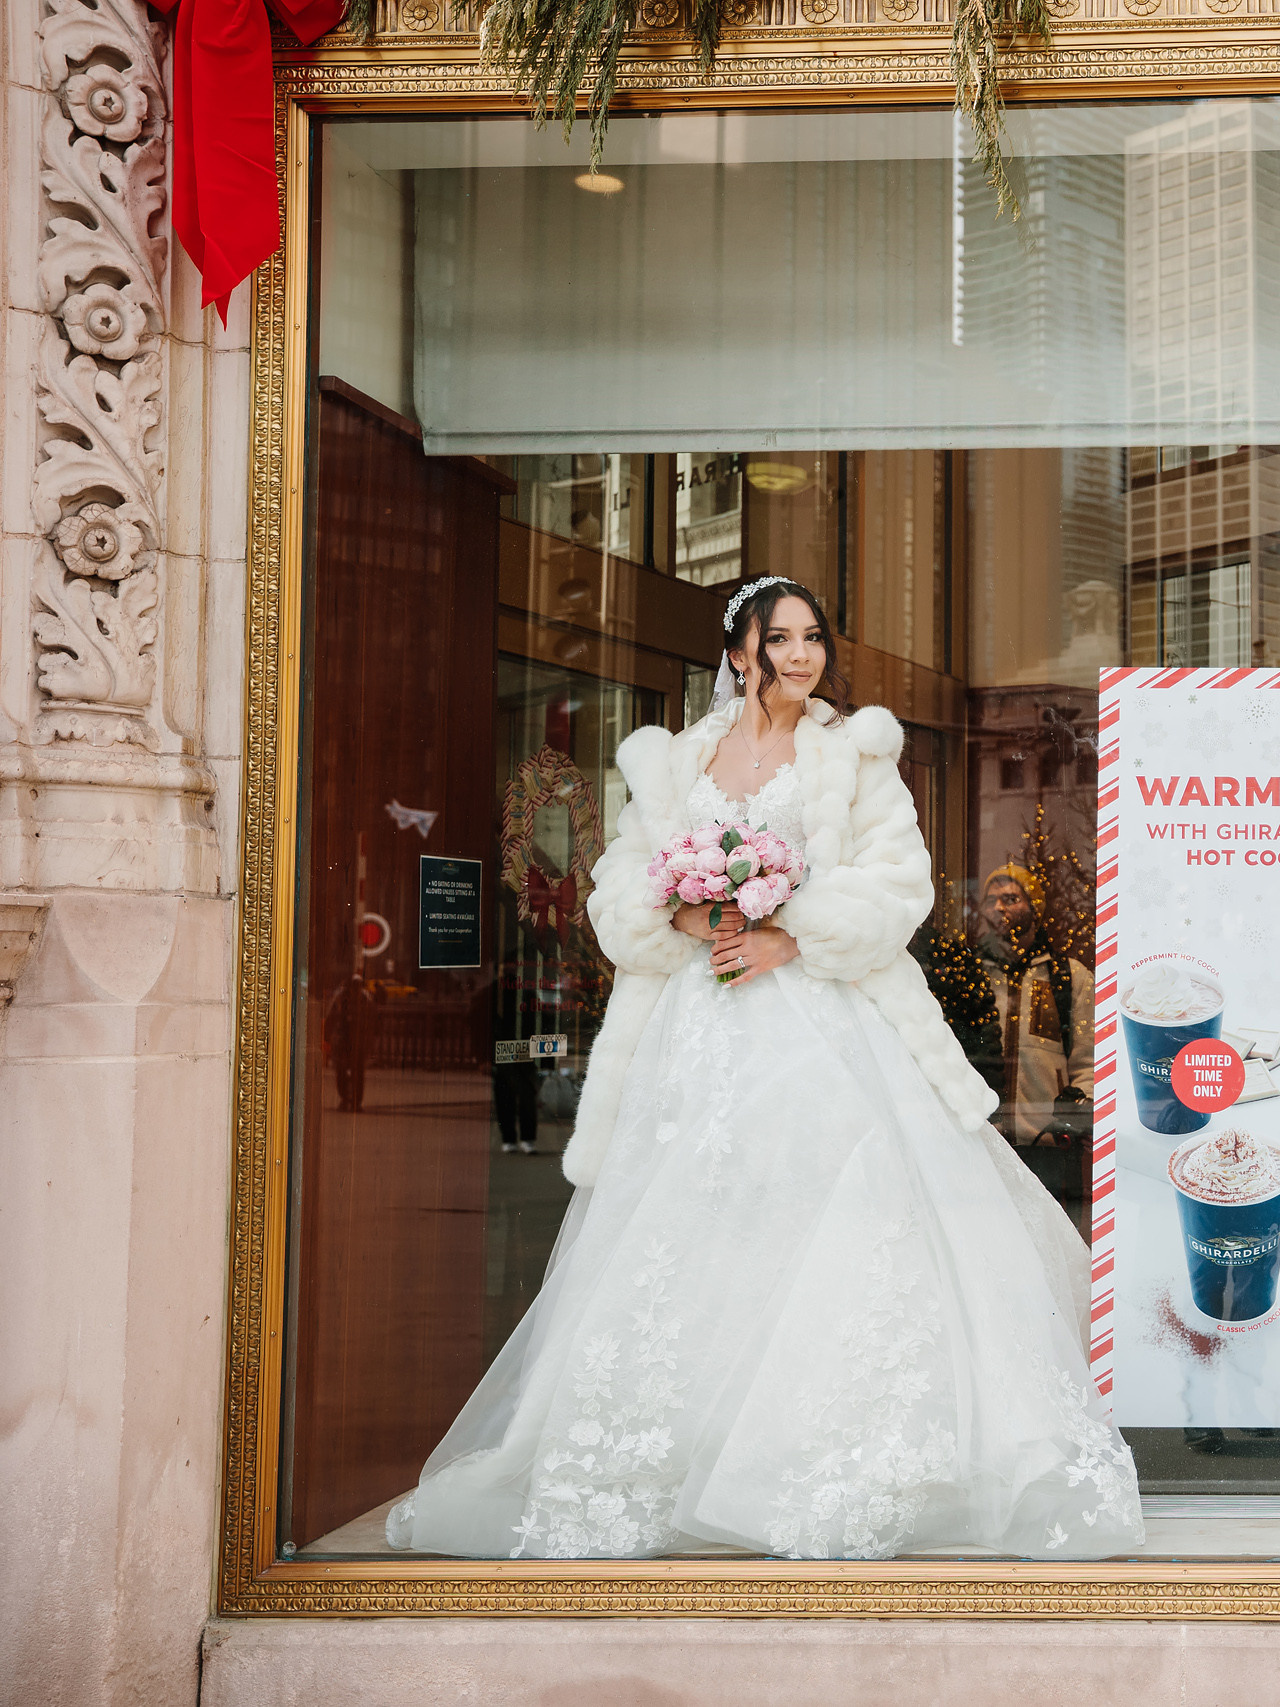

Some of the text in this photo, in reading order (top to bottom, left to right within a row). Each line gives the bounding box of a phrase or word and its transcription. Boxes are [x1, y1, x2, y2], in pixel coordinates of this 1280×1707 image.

[1136, 776, 1280, 807] WARM
[1146, 823, 1207, 840] WITH
[1186, 849, 1236, 866] HOT
[1131, 952, 1220, 979] PEPPERMINT HOT COCOA
[496, 1042, 530, 1054] STAND CLEA
[1184, 1054, 1232, 1067] LIMITED
[1193, 1069, 1223, 1082] TIME
[1193, 1084, 1224, 1098] ONLY
[1190, 1238, 1278, 1259] GHIRARDELLI
[1216, 1324, 1246, 1333] CLASSIC
[1248, 1322, 1262, 1332] HOT
